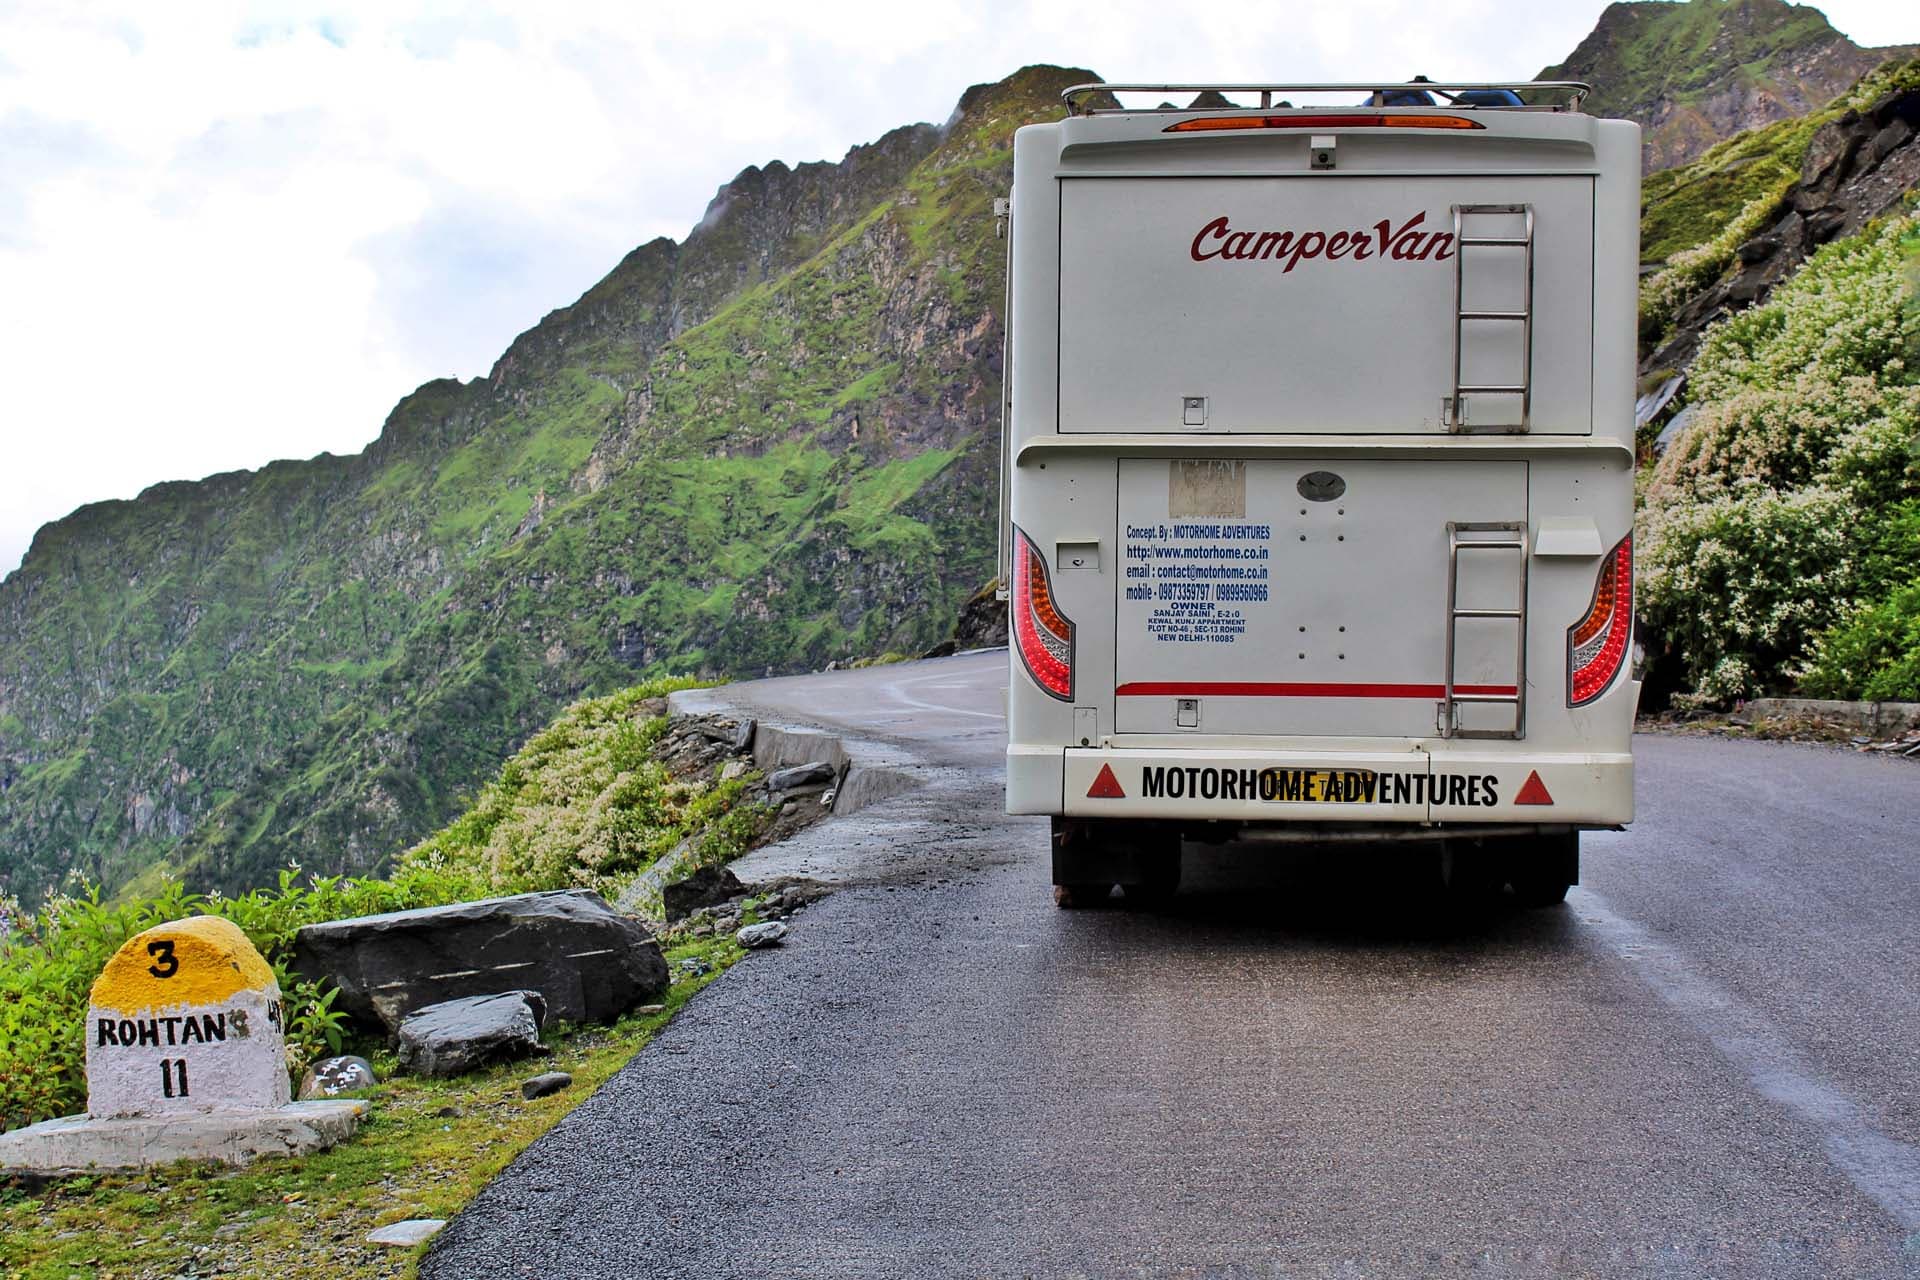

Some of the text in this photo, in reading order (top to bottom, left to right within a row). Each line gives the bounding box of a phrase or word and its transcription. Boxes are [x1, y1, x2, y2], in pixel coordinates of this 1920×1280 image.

[1190, 210, 1455, 274] CamperVan
[1126, 525, 1157, 540] Concept.
[1159, 525, 1168, 541] By
[1173, 525, 1220, 539] MOTORHOME
[1222, 525, 1270, 540] ADVENTURES
[1126, 564, 1150, 578] email
[1157, 564, 1268, 581] contact@motorhome.co.in
[1126, 583, 1152, 600] mobile
[1153, 609, 1184, 617] SANJAY
[1187, 610, 1211, 618] SAINI
[1170, 602, 1215, 610] OWNER
[1148, 624, 1165, 632] PLOT
[1219, 626, 1245, 634] ROHINI
[1197, 618, 1246, 626] APPARTMENT
[1157, 634, 1234, 643] NEW DELHI-110085
[1142, 767, 1317, 801] MOTORHOME
[1324, 771, 1499, 807] ADVENTURES
[147, 940, 179, 979] 3
[160, 1058, 189, 1098] 11
